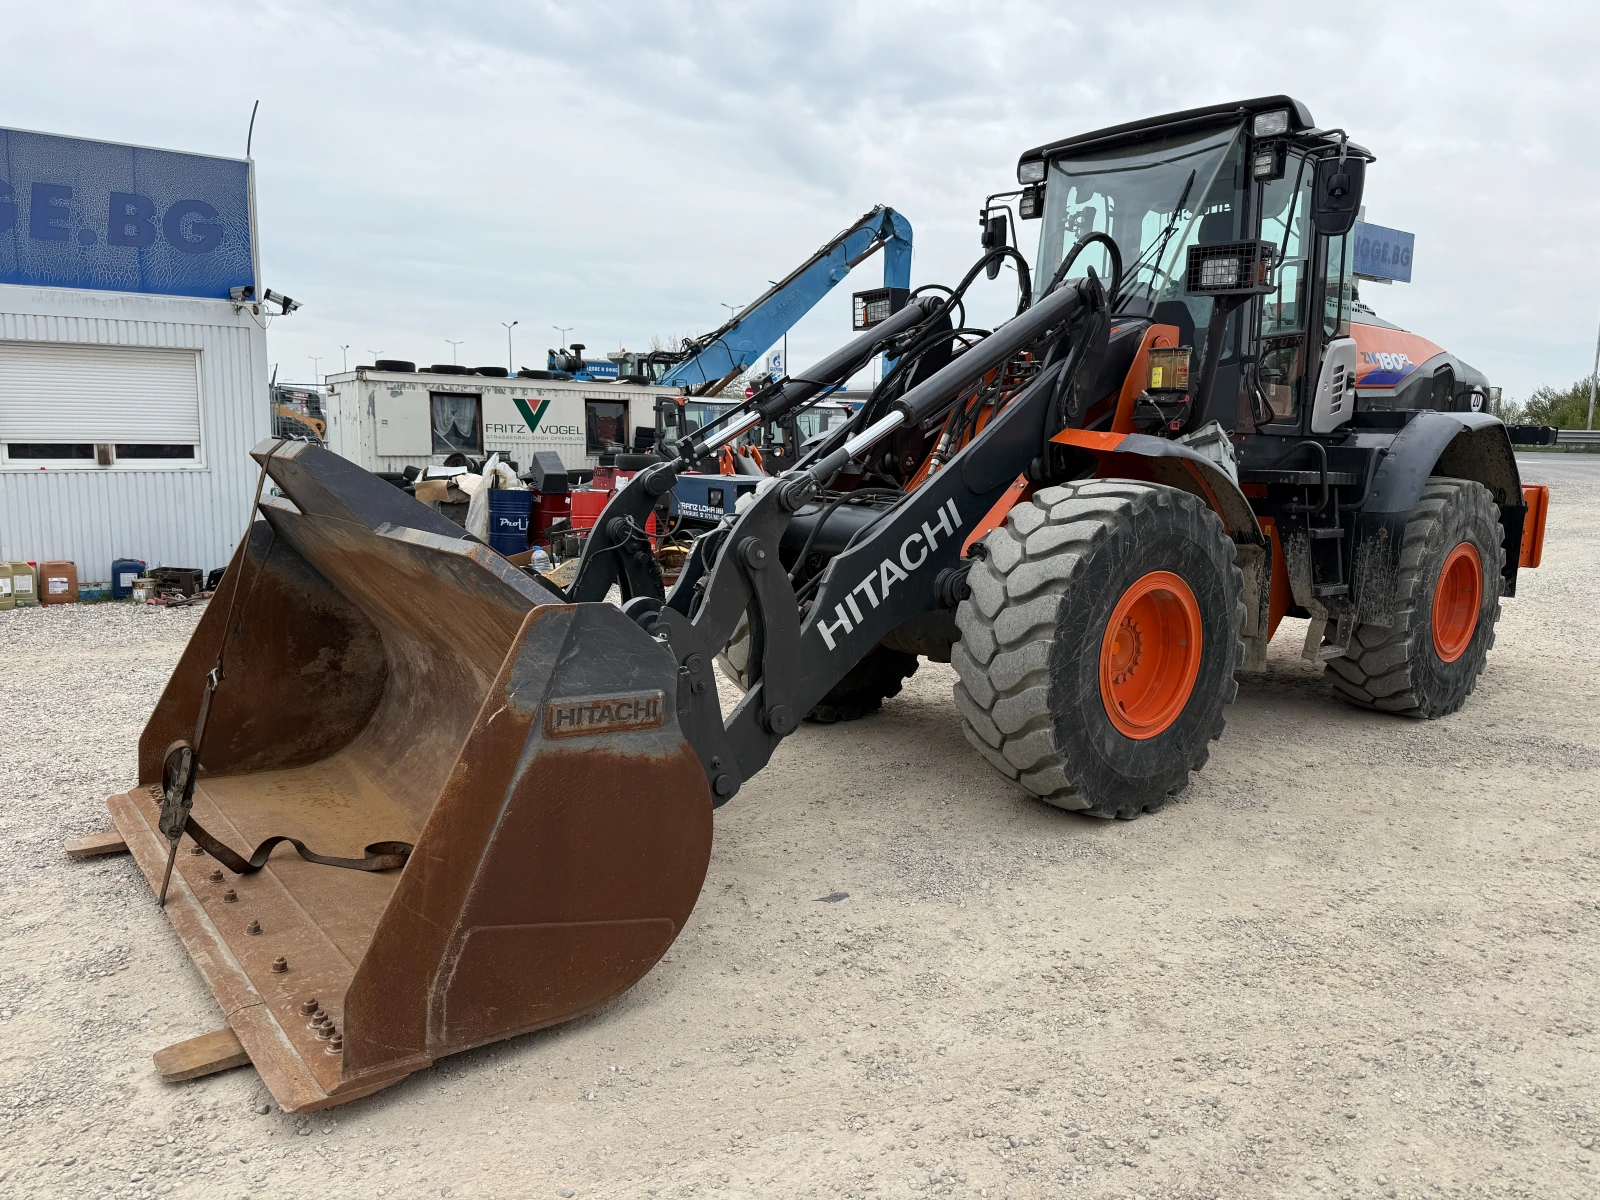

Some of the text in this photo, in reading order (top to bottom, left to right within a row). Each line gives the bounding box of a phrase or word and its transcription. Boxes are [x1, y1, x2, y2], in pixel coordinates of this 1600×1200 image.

[777, 286, 802, 309] TEREX
[485, 423, 584, 435] FRITZ VOGEL
[816, 497, 963, 652] HITACHI
[556, 700, 658, 728] HITACHI
